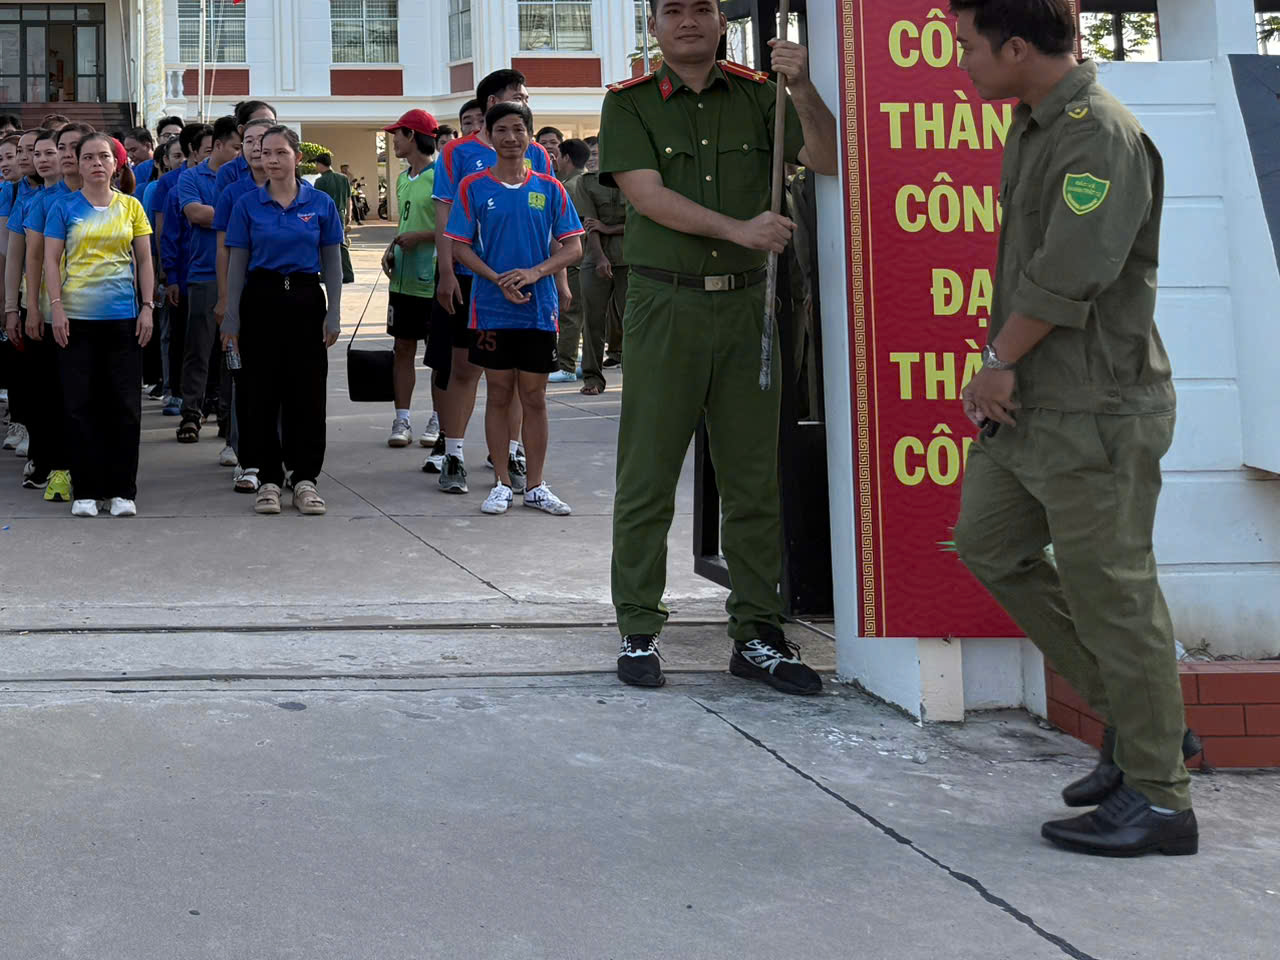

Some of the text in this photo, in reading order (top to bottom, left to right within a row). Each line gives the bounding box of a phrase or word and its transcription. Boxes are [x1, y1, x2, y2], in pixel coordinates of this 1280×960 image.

[888, 7, 965, 68] CÔ
[880, 90, 1013, 150] THÀN
[895, 172, 1003, 233] CÔN
[930, 268, 993, 328] ĐẠ
[893, 423, 974, 486] CÔ
